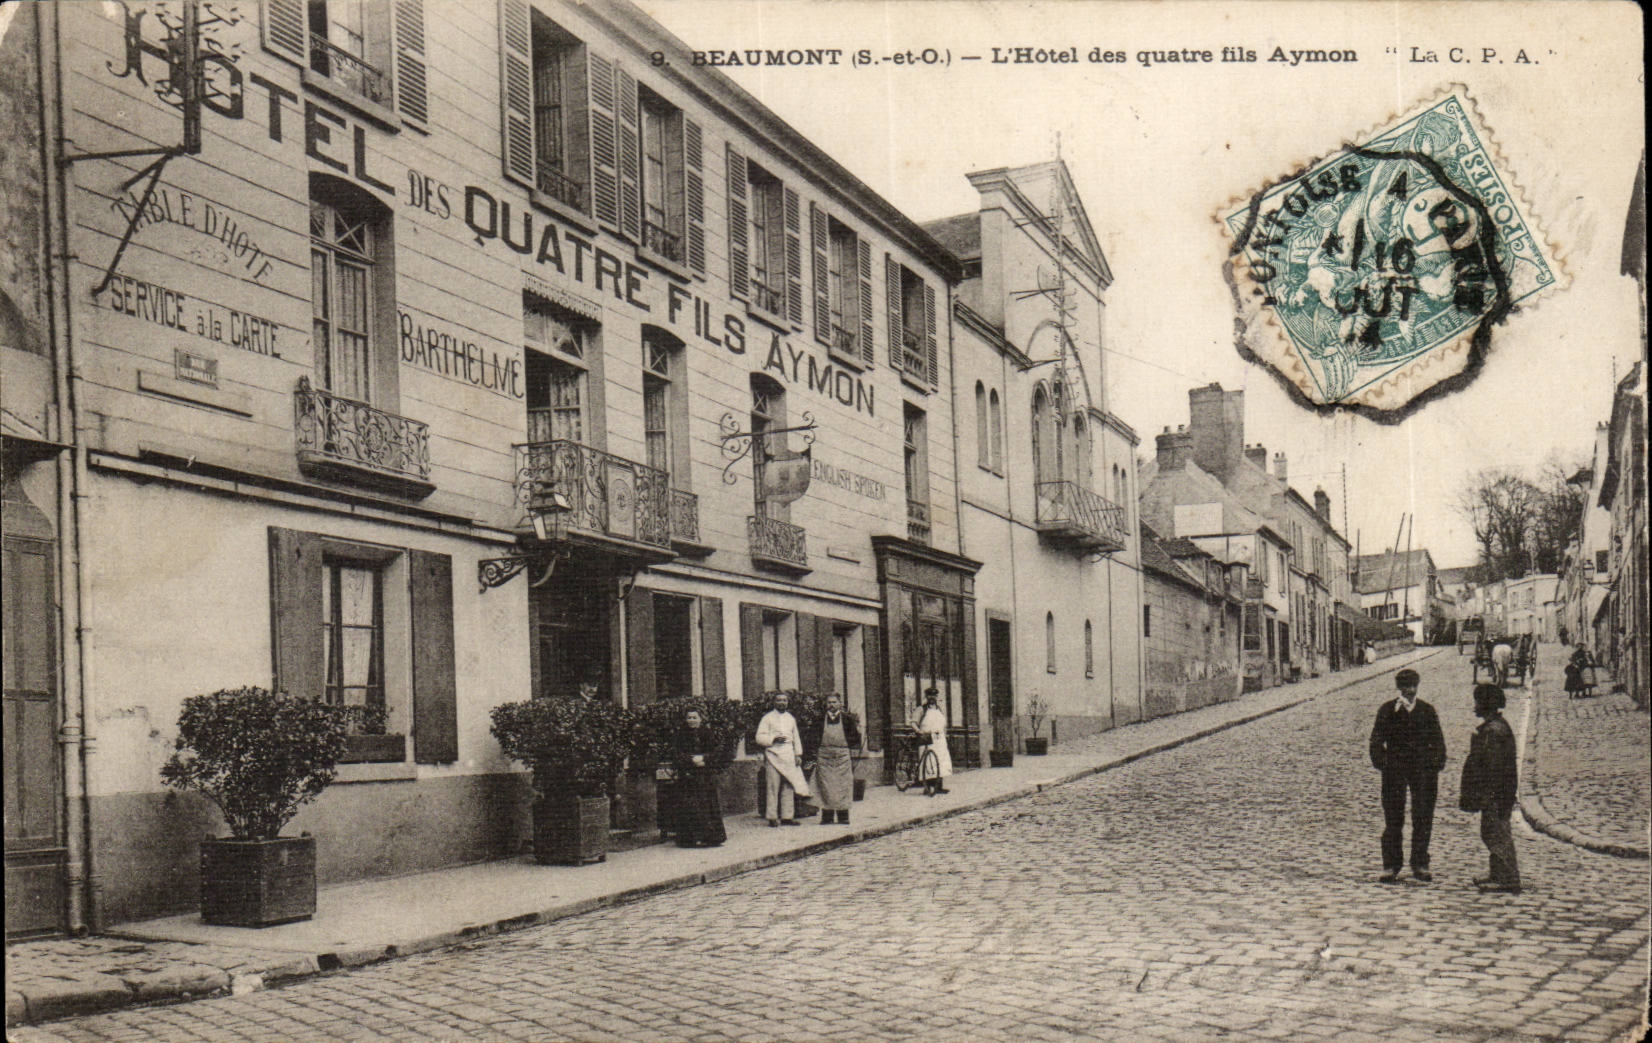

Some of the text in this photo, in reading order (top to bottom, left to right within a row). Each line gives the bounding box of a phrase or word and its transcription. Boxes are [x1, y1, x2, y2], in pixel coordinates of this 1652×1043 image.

[110, 190, 195, 234] TABLE
[1464, 153, 1524, 242] POSTES
[111, 276, 188, 332] SERVICE
[230, 311, 281, 359] CARTE
[404, 169, 451, 219] DES
[464, 184, 651, 312] QUATRE
[668, 282, 747, 354] FILS
[761, 331, 875, 418] AYMON
[397, 310, 524, 399] BARTHELMÉ
